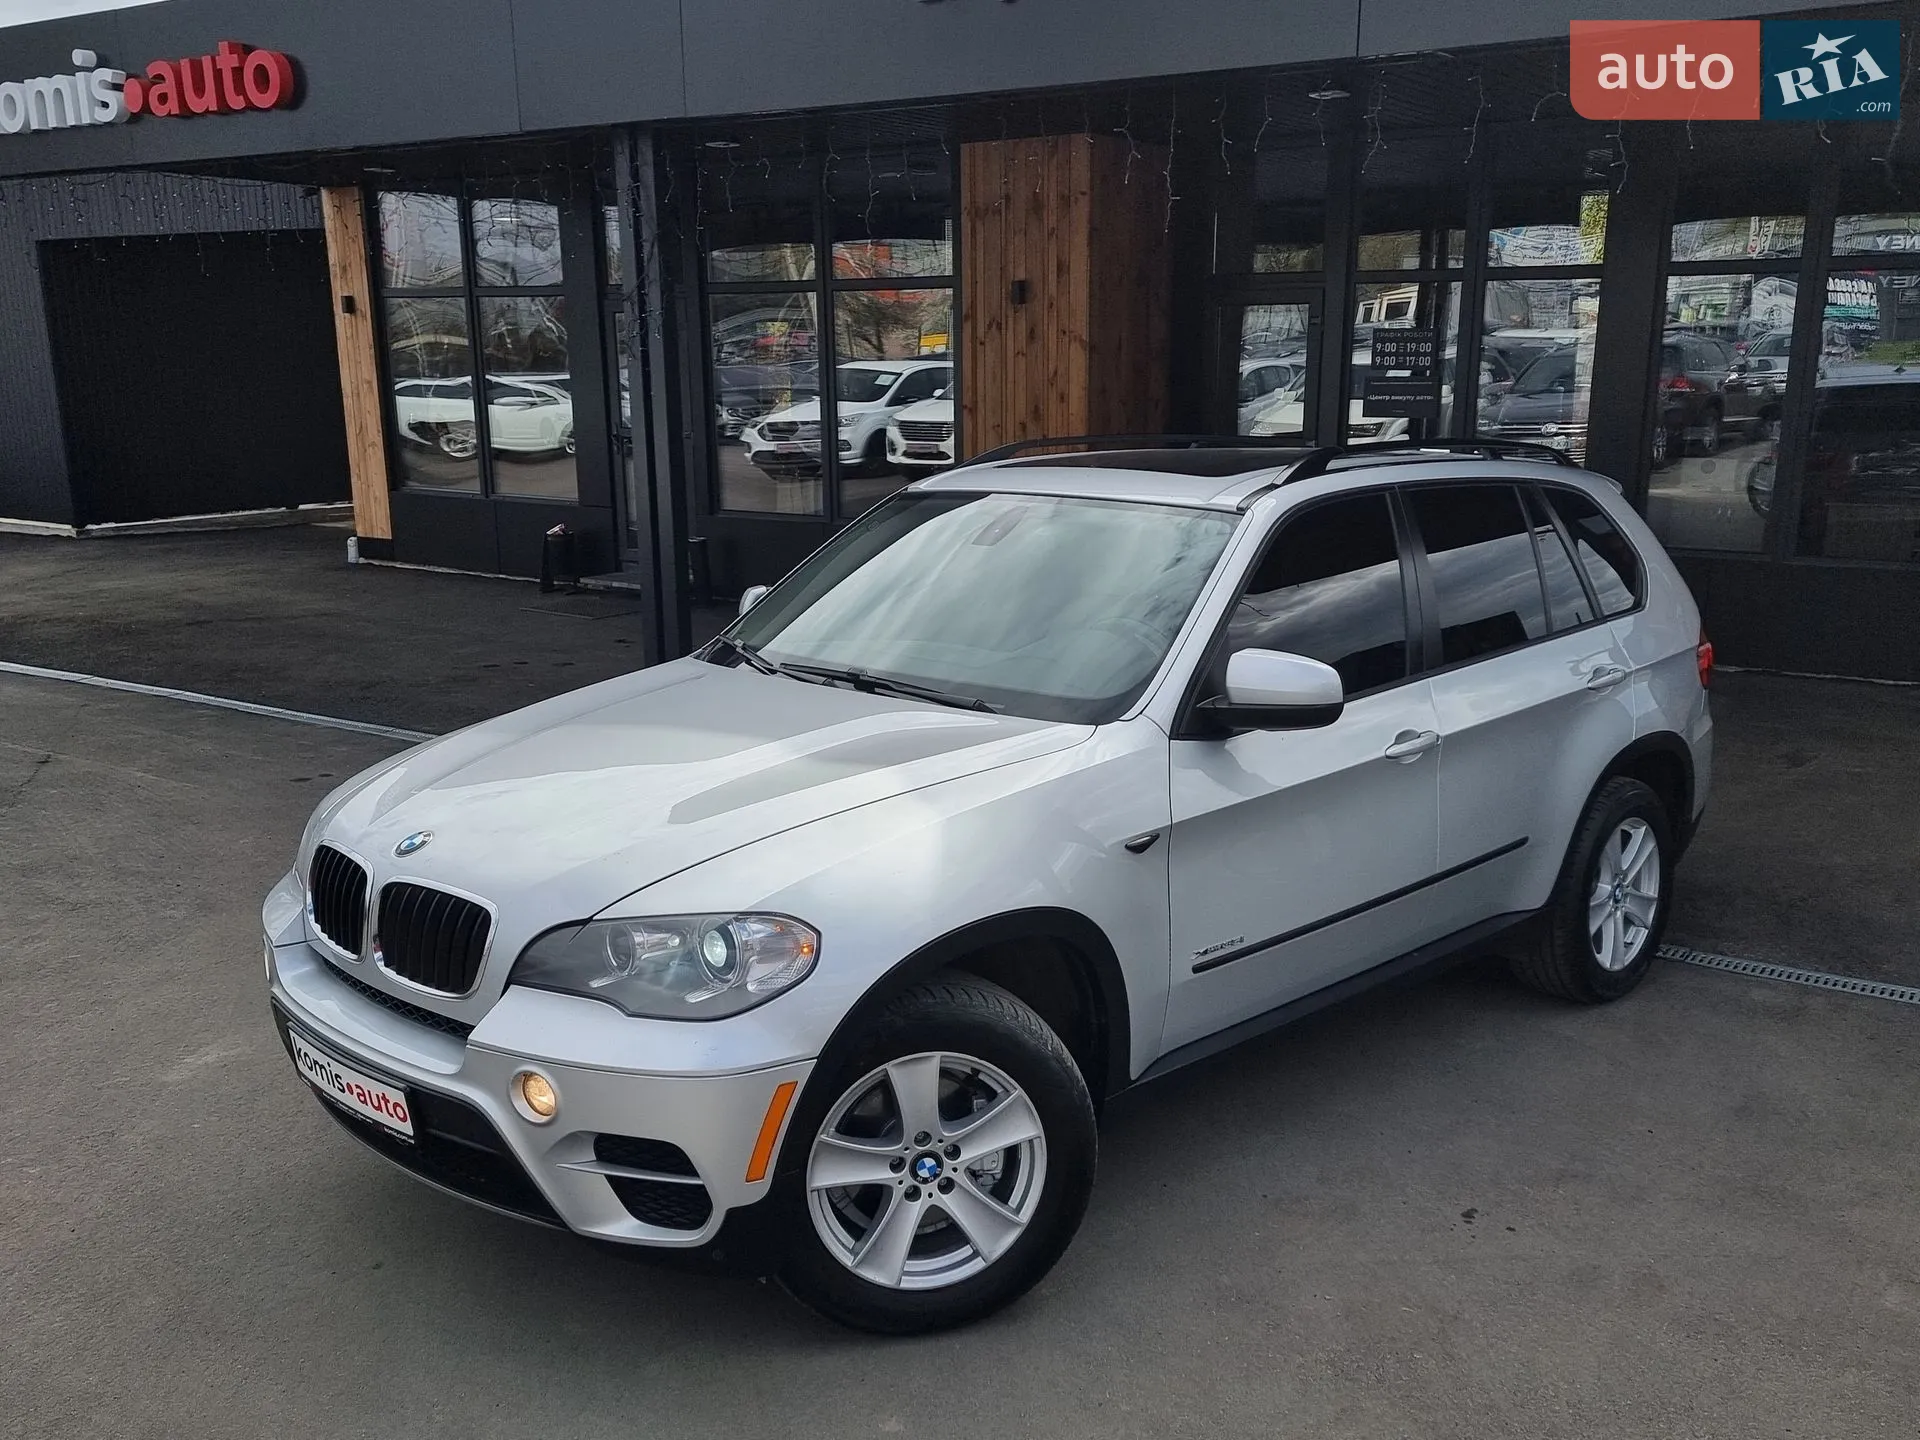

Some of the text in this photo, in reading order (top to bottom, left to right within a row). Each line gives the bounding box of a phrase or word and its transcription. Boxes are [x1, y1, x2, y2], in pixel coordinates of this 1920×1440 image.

[1376, 342, 1432, 353] 9:00 19:00
[1375, 356, 1431, 366] 9:00 17:00
